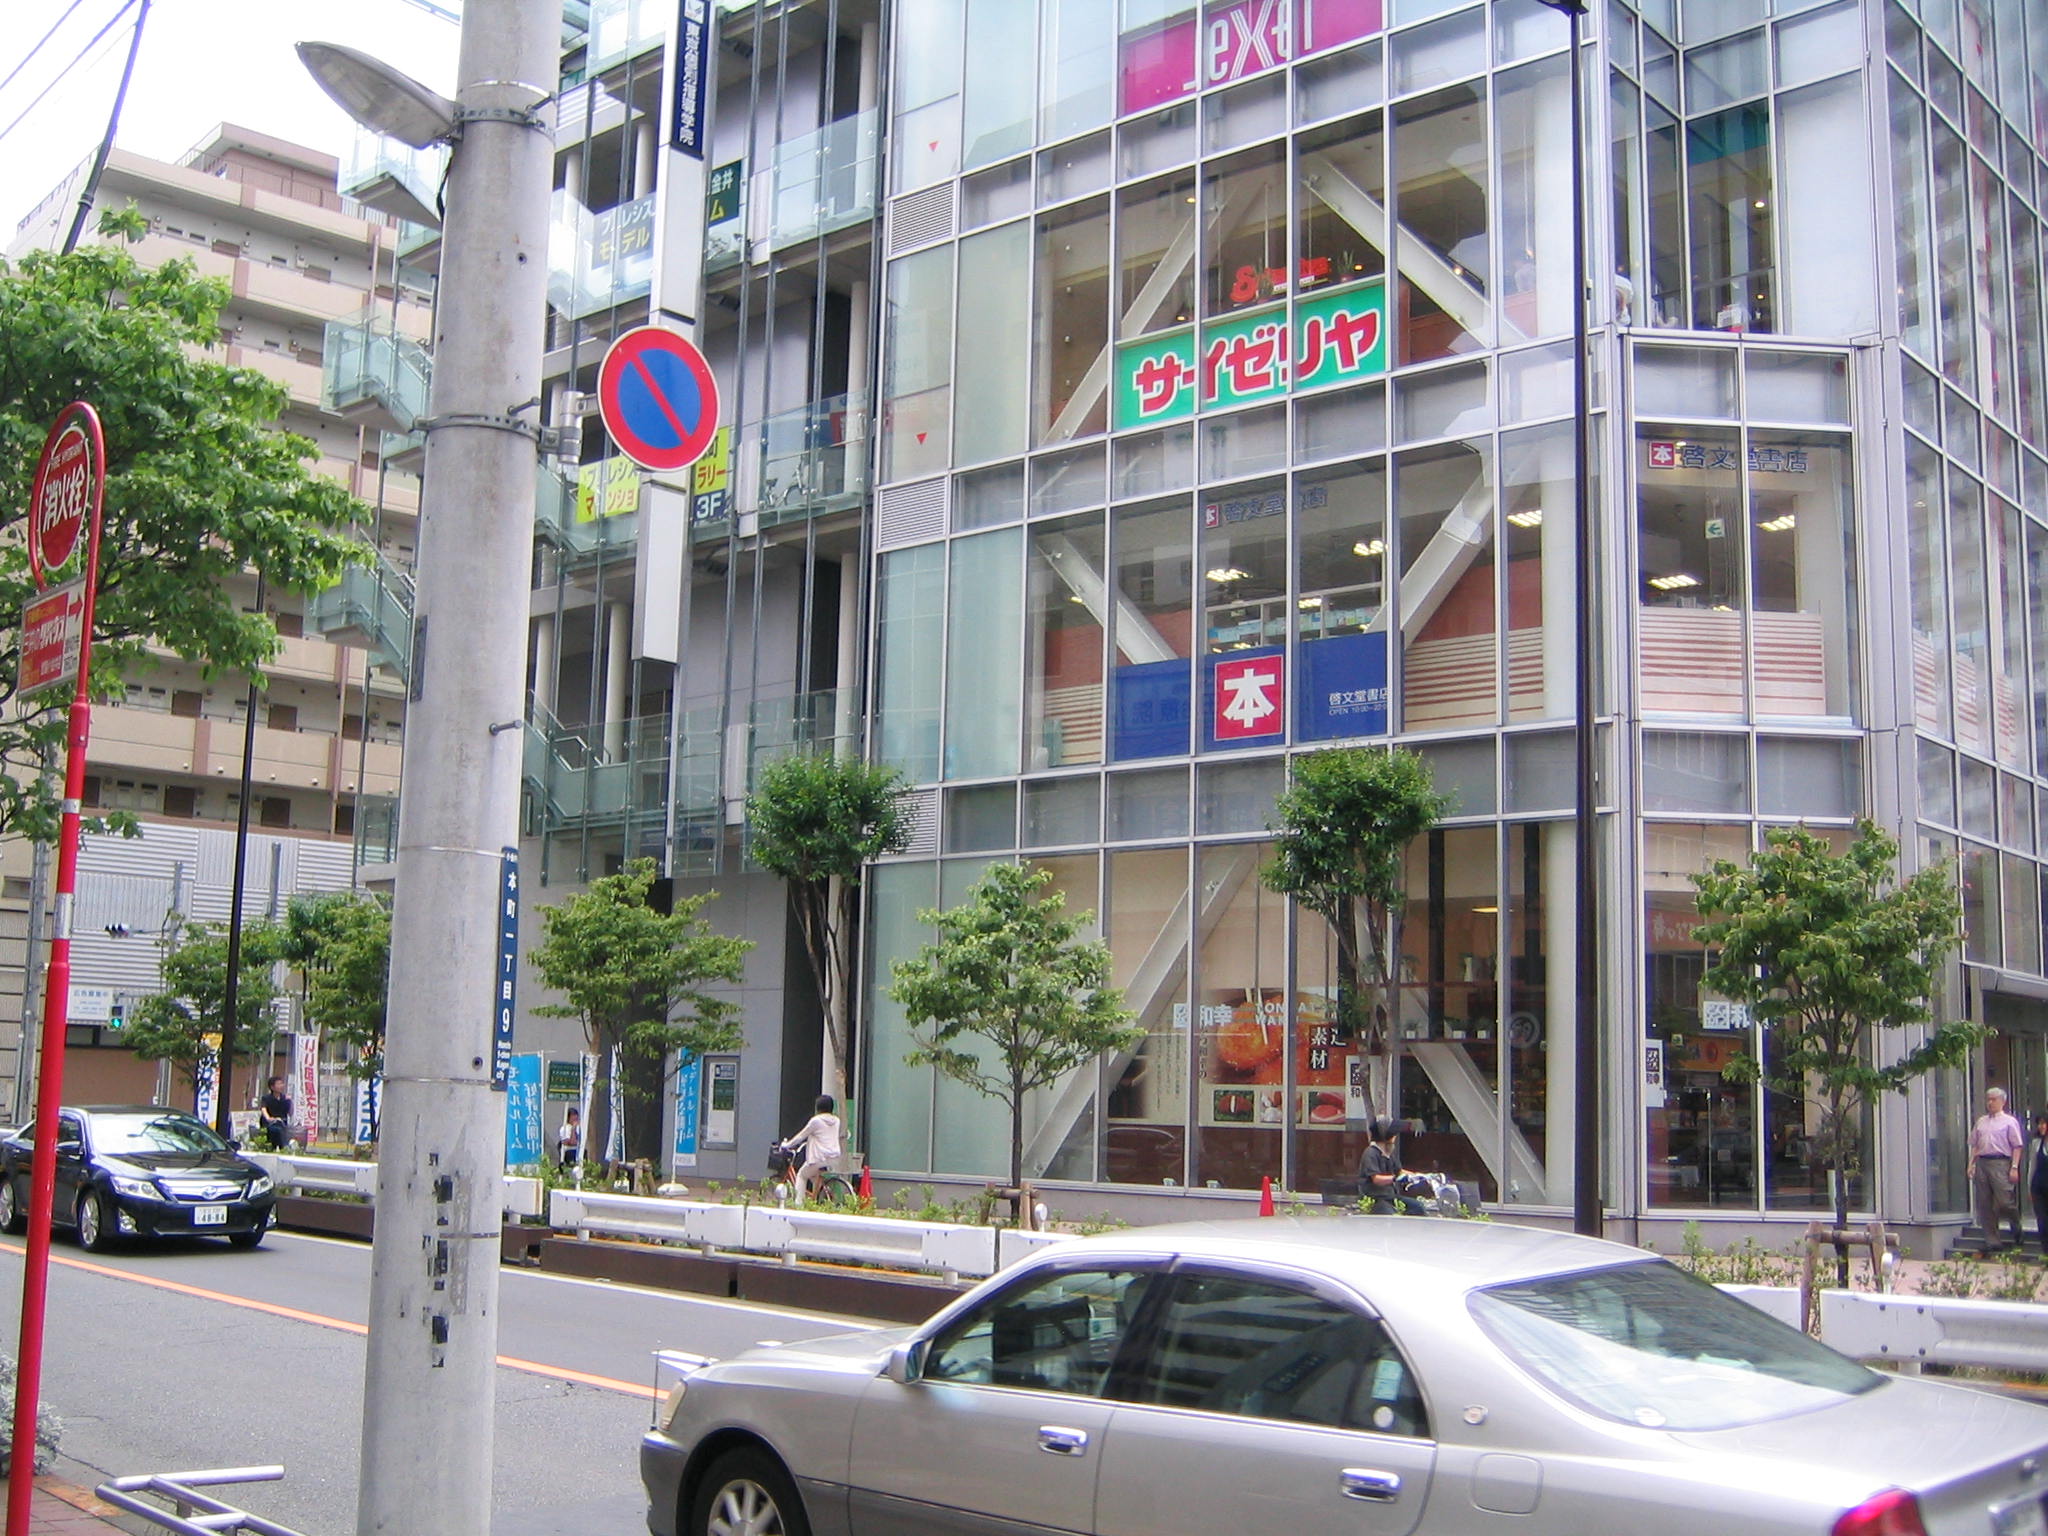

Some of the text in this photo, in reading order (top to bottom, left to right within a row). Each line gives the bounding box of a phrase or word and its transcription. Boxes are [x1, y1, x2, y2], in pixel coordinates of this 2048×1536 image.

[1133, 308, 1380, 417] サイゼリヤ
[1654, 445, 1672, 463] 本
[42, 463, 85, 533] 消火栓
[696, 492, 722, 519] 3F
[1222, 668, 1275, 728] 本
[1311, 1026, 1328, 1069] 素材
